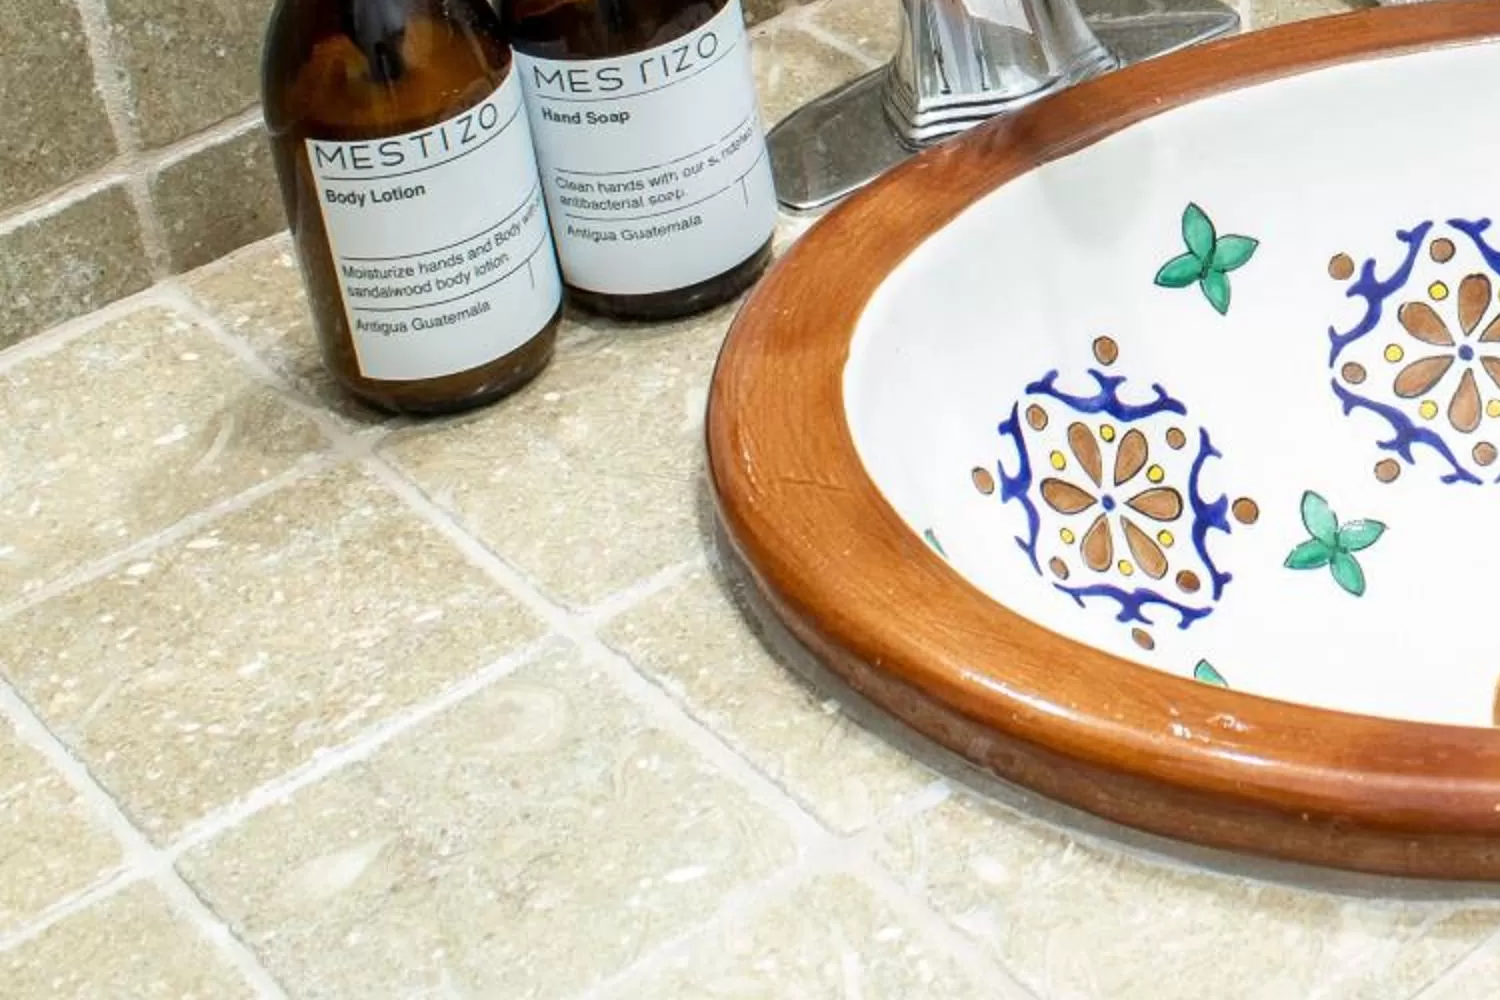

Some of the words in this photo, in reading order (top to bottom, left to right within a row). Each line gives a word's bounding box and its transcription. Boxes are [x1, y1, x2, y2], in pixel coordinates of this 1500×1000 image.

[532, 31, 719, 93] MESTIZO
[541, 107, 581, 125] Hand
[586, 109, 630, 125] Soap
[315, 103, 498, 170] MESTIZO
[326, 188, 365, 206] Body
[370, 184, 426, 204] Lotion
[555, 176, 594, 193] Clean
[597, 179, 645, 194] hands
[648, 171, 679, 188] with
[560, 194, 644, 211] antibacterial
[567, 224, 617, 243] Antigua
[620, 214, 703, 242] Guatemala
[342, 264, 415, 280] Moisturize
[418, 253, 464, 273] hands
[467, 238, 493, 261] and
[494, 221, 521, 246] Body
[347, 280, 433, 299] sandalwood
[435, 271, 471, 291] body
[474, 253, 510, 277] lotion
[356, 317, 409, 336] Antigua
[411, 300, 491, 332] Guatemala
